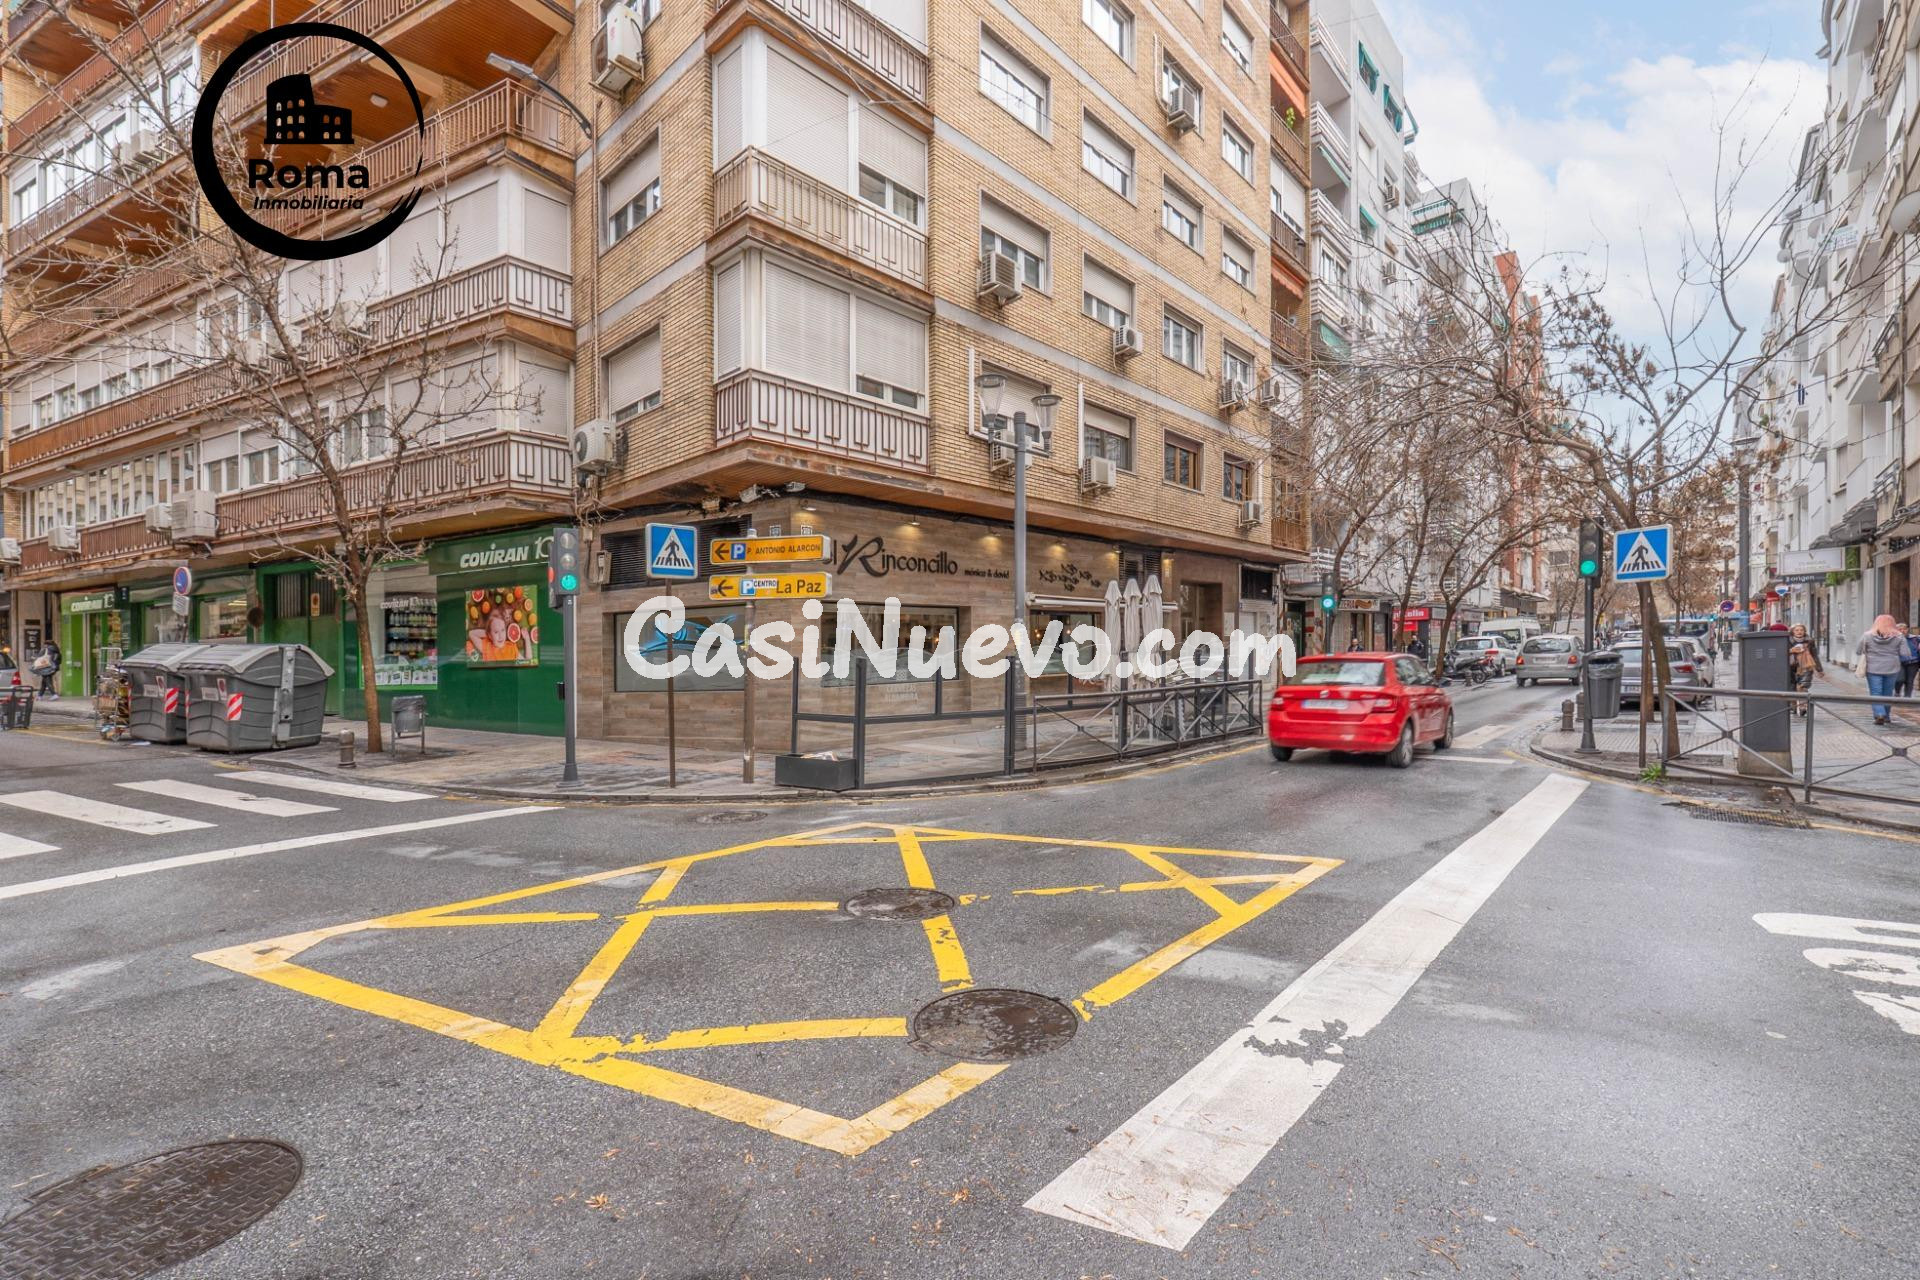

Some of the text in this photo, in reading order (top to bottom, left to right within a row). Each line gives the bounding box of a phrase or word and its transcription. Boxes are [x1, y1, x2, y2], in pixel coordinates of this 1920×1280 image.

[755, 546, 786, 554] ANTONIO
[836, 534, 958, 577] Rinconcillo
[776, 580, 792, 594] La
[796, 579, 822, 593] Paz
